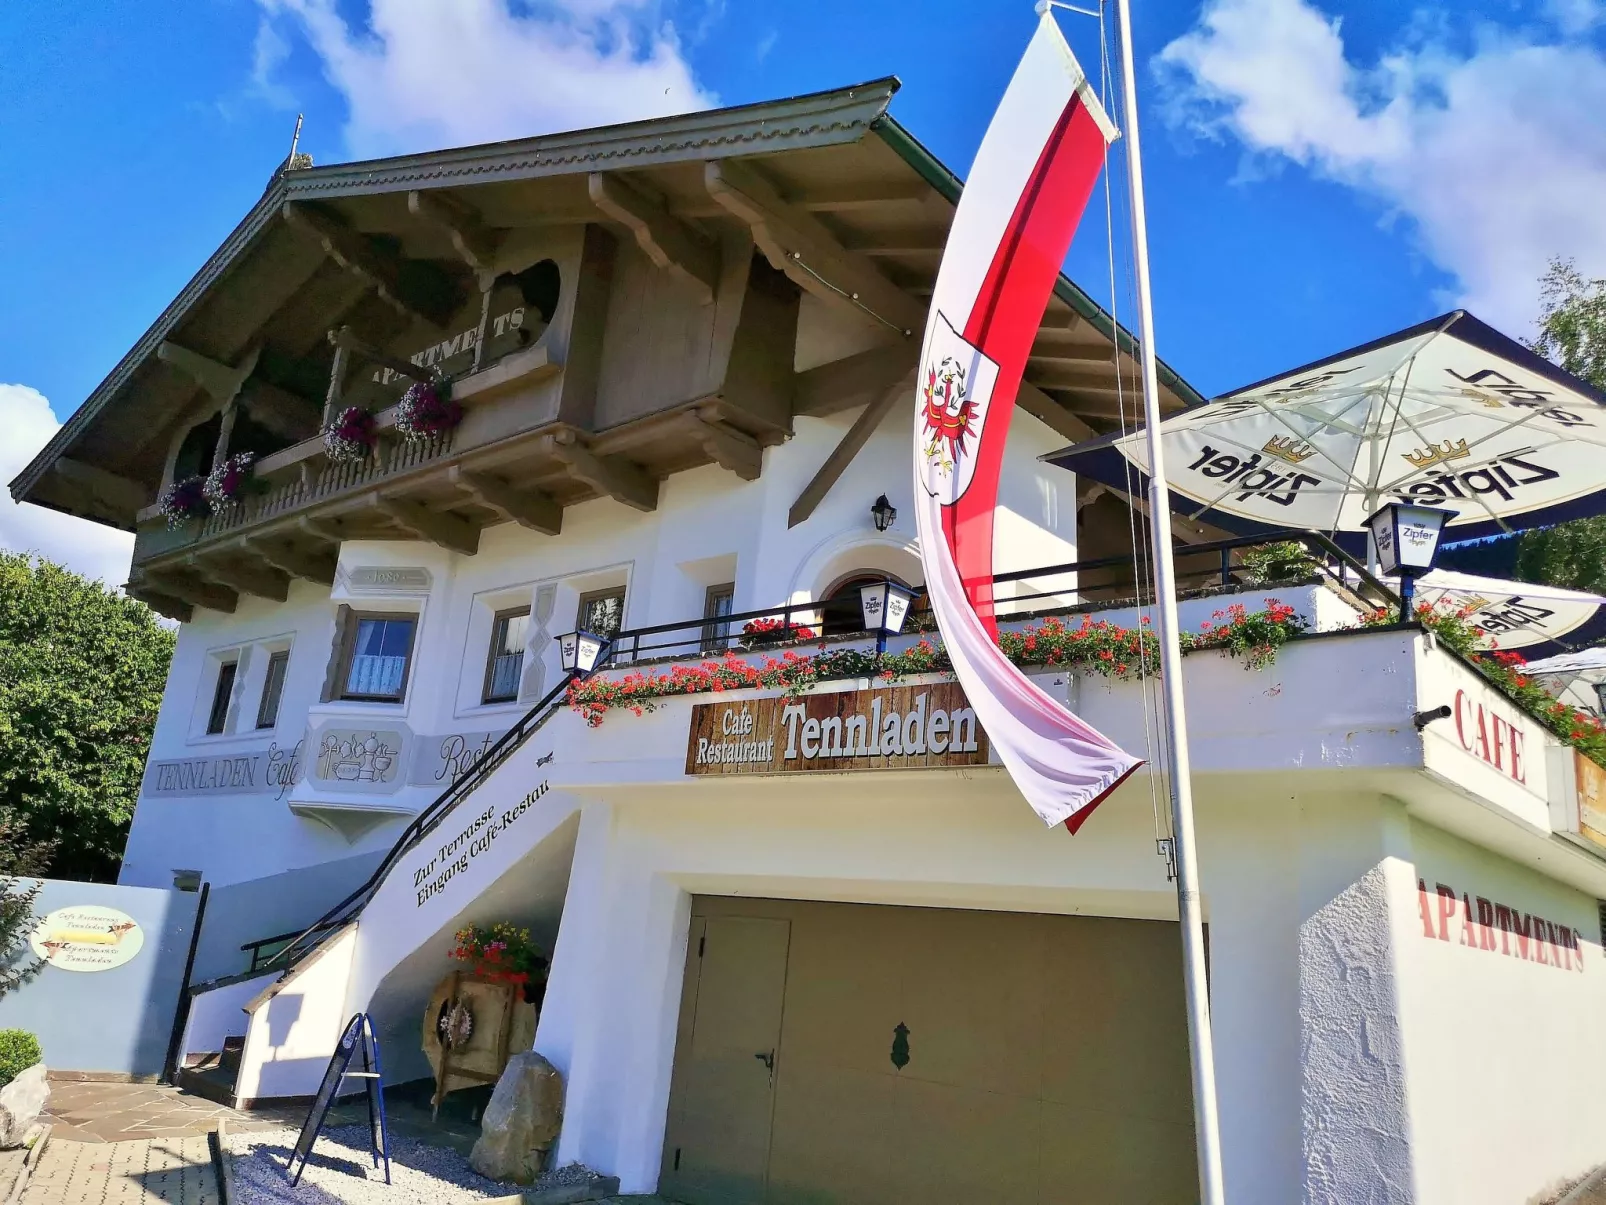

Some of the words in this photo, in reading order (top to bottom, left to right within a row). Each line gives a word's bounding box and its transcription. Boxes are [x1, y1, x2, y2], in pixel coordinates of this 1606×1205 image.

[1403, 527, 1434, 541] Zipfer
[696, 736, 774, 765] Restaurant
[781, 693, 978, 760] Tennladen
[1455, 689, 1526, 785] CAFE
[156, 756, 260, 791] TENNLADEN
[413, 858, 437, 888] Zur
[438, 805, 495, 863] Terrasse
[416, 852, 468, 908] Eingang
[1418, 877, 1585, 973] APARTMENTS
